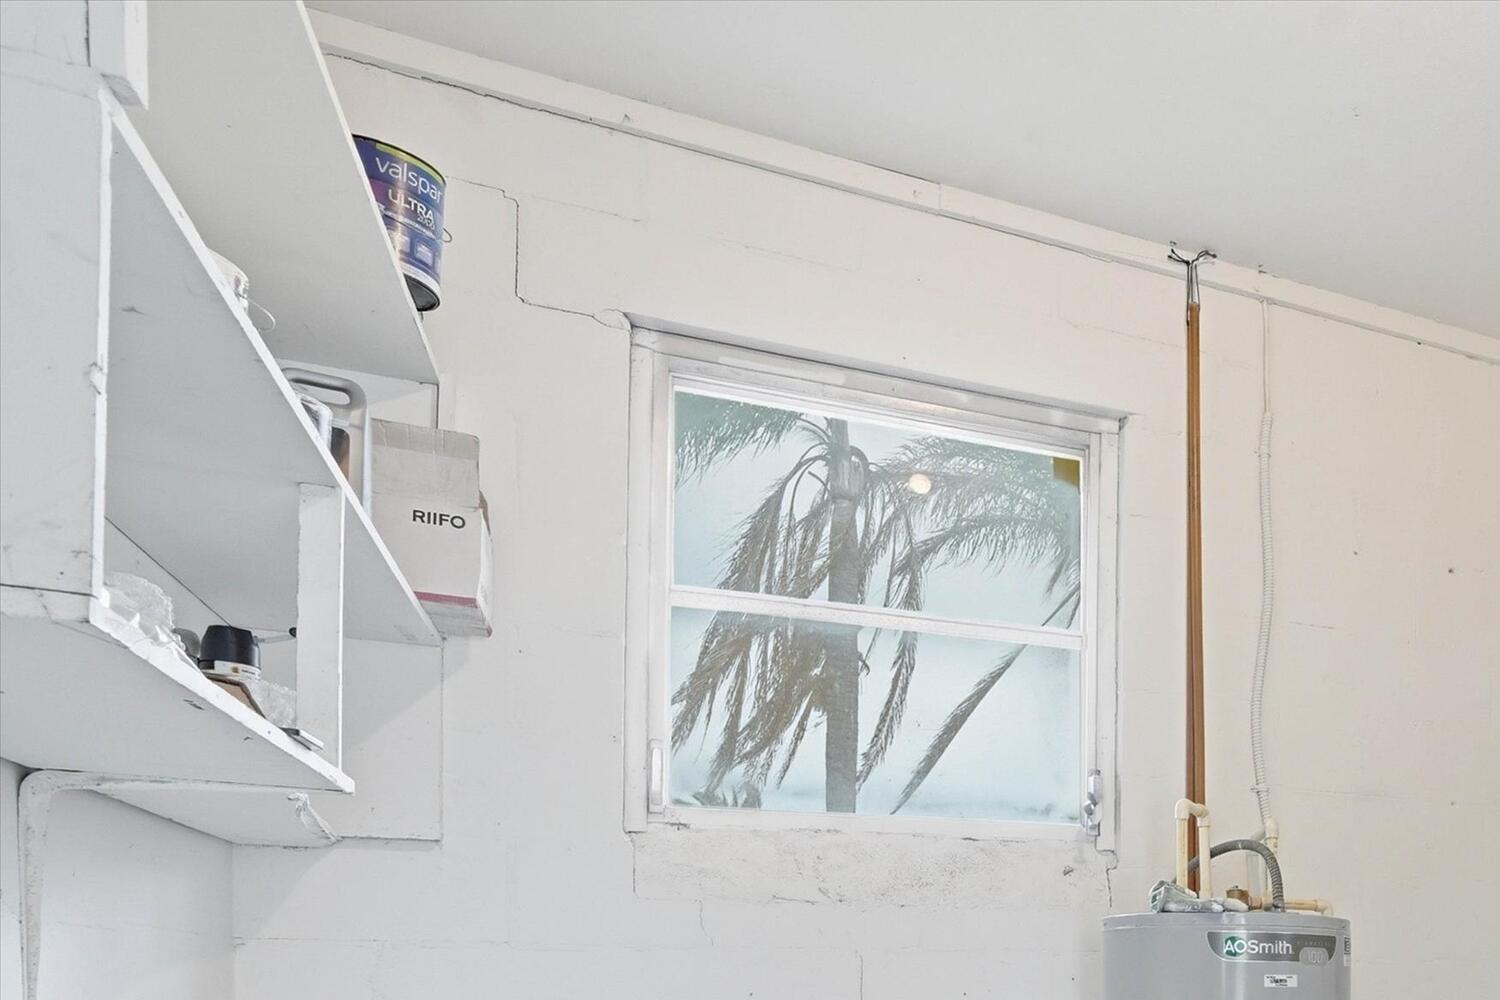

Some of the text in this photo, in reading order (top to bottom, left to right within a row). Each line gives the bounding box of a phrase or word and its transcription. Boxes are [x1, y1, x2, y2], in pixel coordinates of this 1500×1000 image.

[375, 157, 443, 204] valspar
[388, 189, 435, 222] ULTRA
[412, 509, 466, 529] RIIFO
